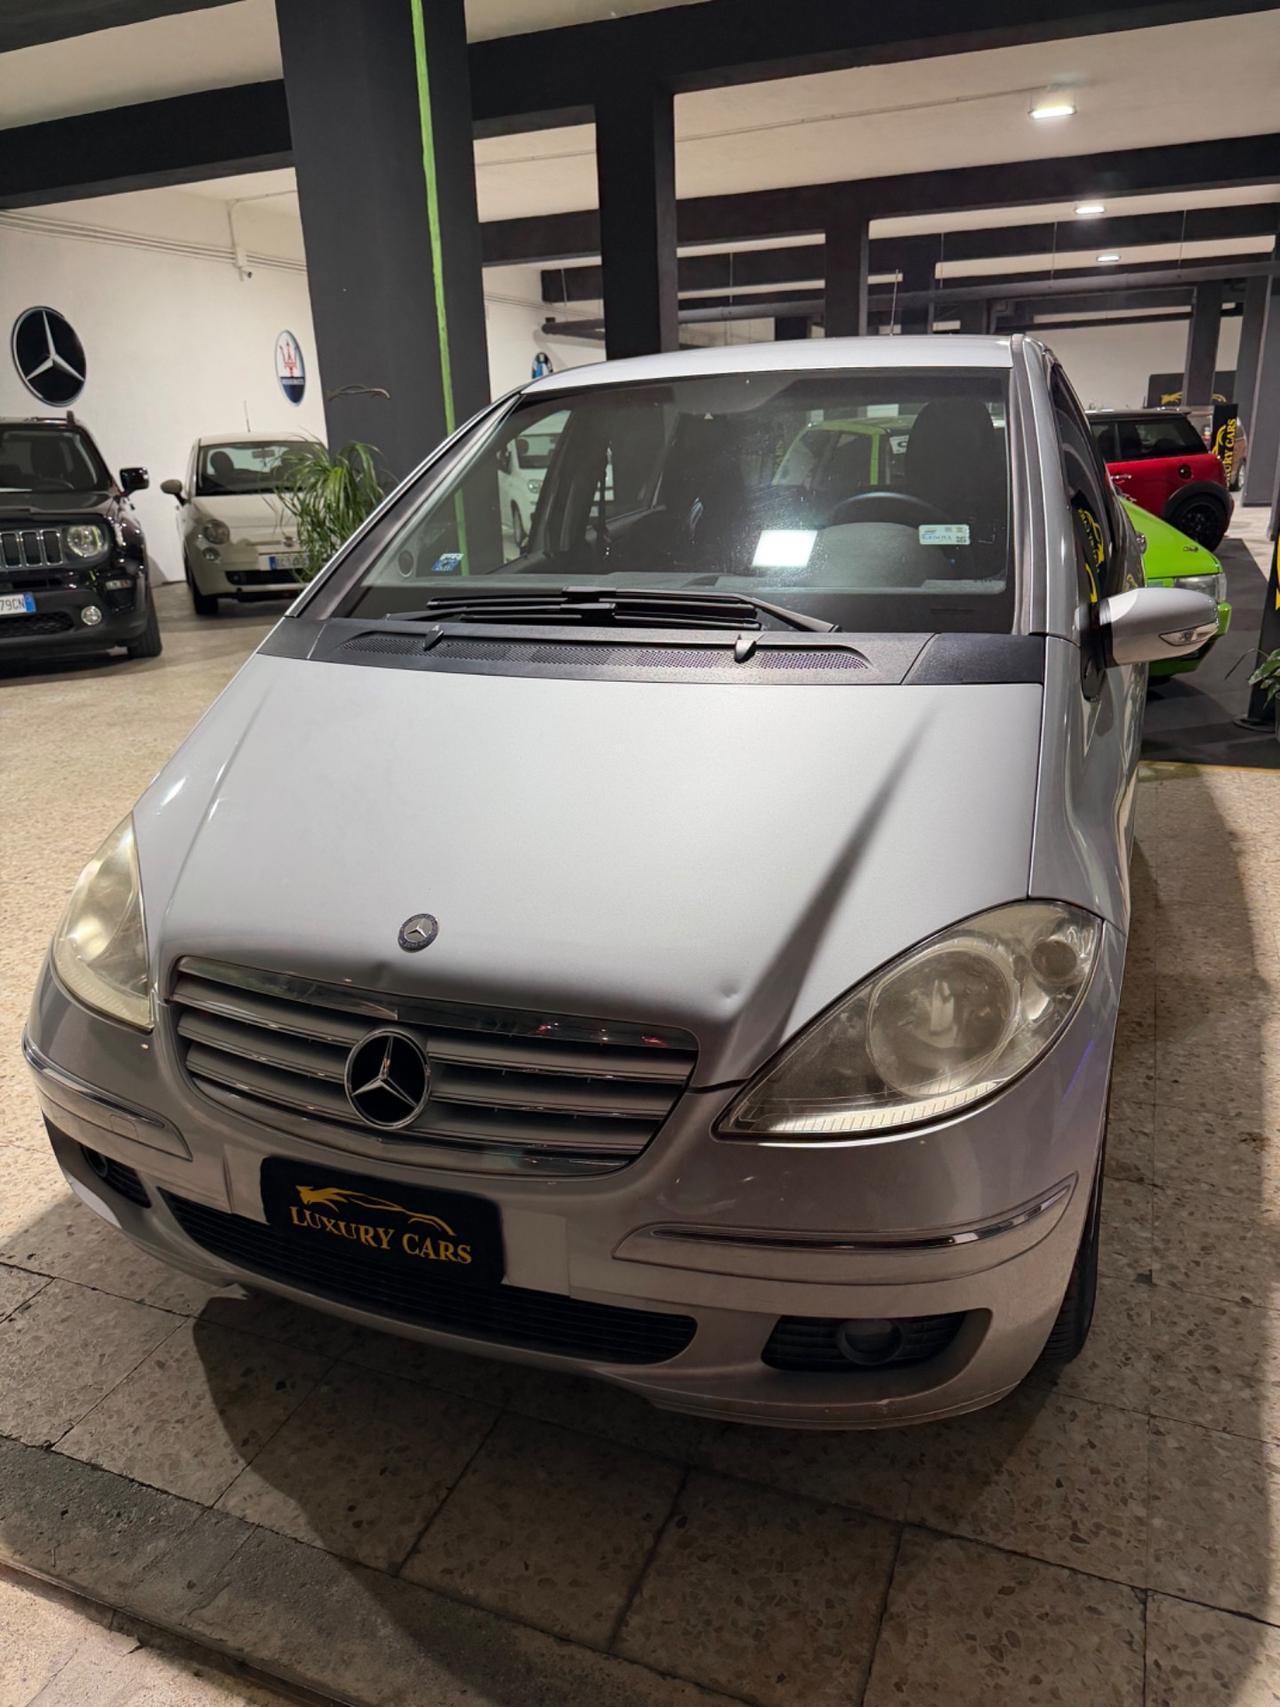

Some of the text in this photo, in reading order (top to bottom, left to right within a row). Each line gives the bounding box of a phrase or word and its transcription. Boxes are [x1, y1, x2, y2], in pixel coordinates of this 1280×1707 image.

[1224, 418, 1237, 448] CARS
[289, 1205, 473, 1265] LUXURY CARS
